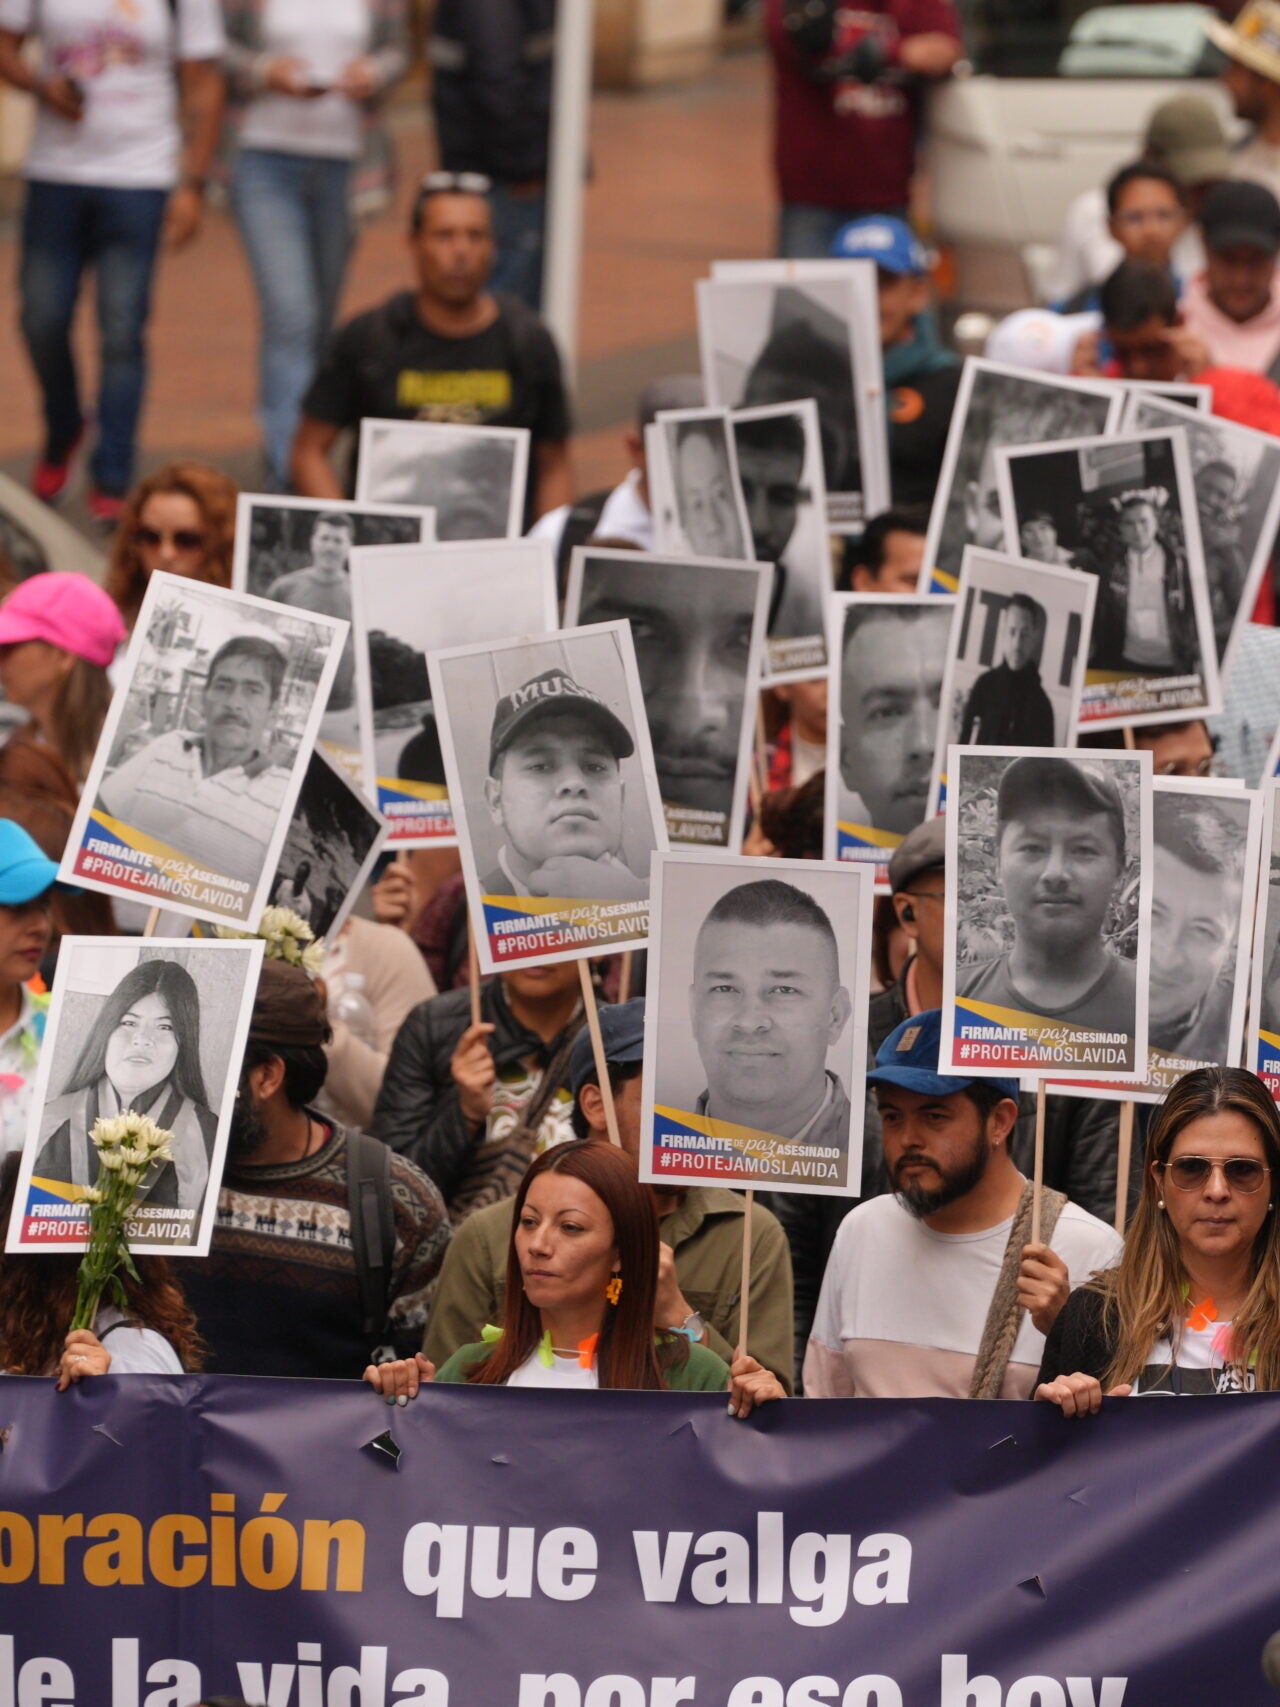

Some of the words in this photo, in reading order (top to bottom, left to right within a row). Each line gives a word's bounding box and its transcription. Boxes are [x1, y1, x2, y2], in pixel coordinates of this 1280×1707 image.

[87, 838, 154, 868] FIRMANTE
[159, 858, 195, 882] paz
[191, 871, 250, 895] ASESINADO
[81, 855, 244, 913] #PROTEJAMOSLAVIDA
[492, 913, 561, 936] FIRMANTE
[569, 904, 601, 927] paz
[960, 1026, 1028, 1041] FIRMANTE
[1028, 1027, 1039, 1038] DE
[1036, 1026, 1070, 1048] paz
[1068, 1031, 1128, 1045] ASESINADO
[960, 1043, 1128, 1065] #PROTEJAMOSLAVIDA
[660, 1133, 733, 1152] FIRMANTE
[733, 1138, 745, 1148] DE
[742, 1137, 777, 1159] paz
[776, 1143, 840, 1160] ASESINADO
[660, 1152, 839, 1179] #PROTEJAMOSLAVIDA
[30, 1203, 92, 1218] FIRMANT
[135, 1208, 195, 1220] ASESINADO
[403, 1522, 598, 1619] que
[633, 1511, 912, 1627] valga
[111, 1637, 201, 1707] la
